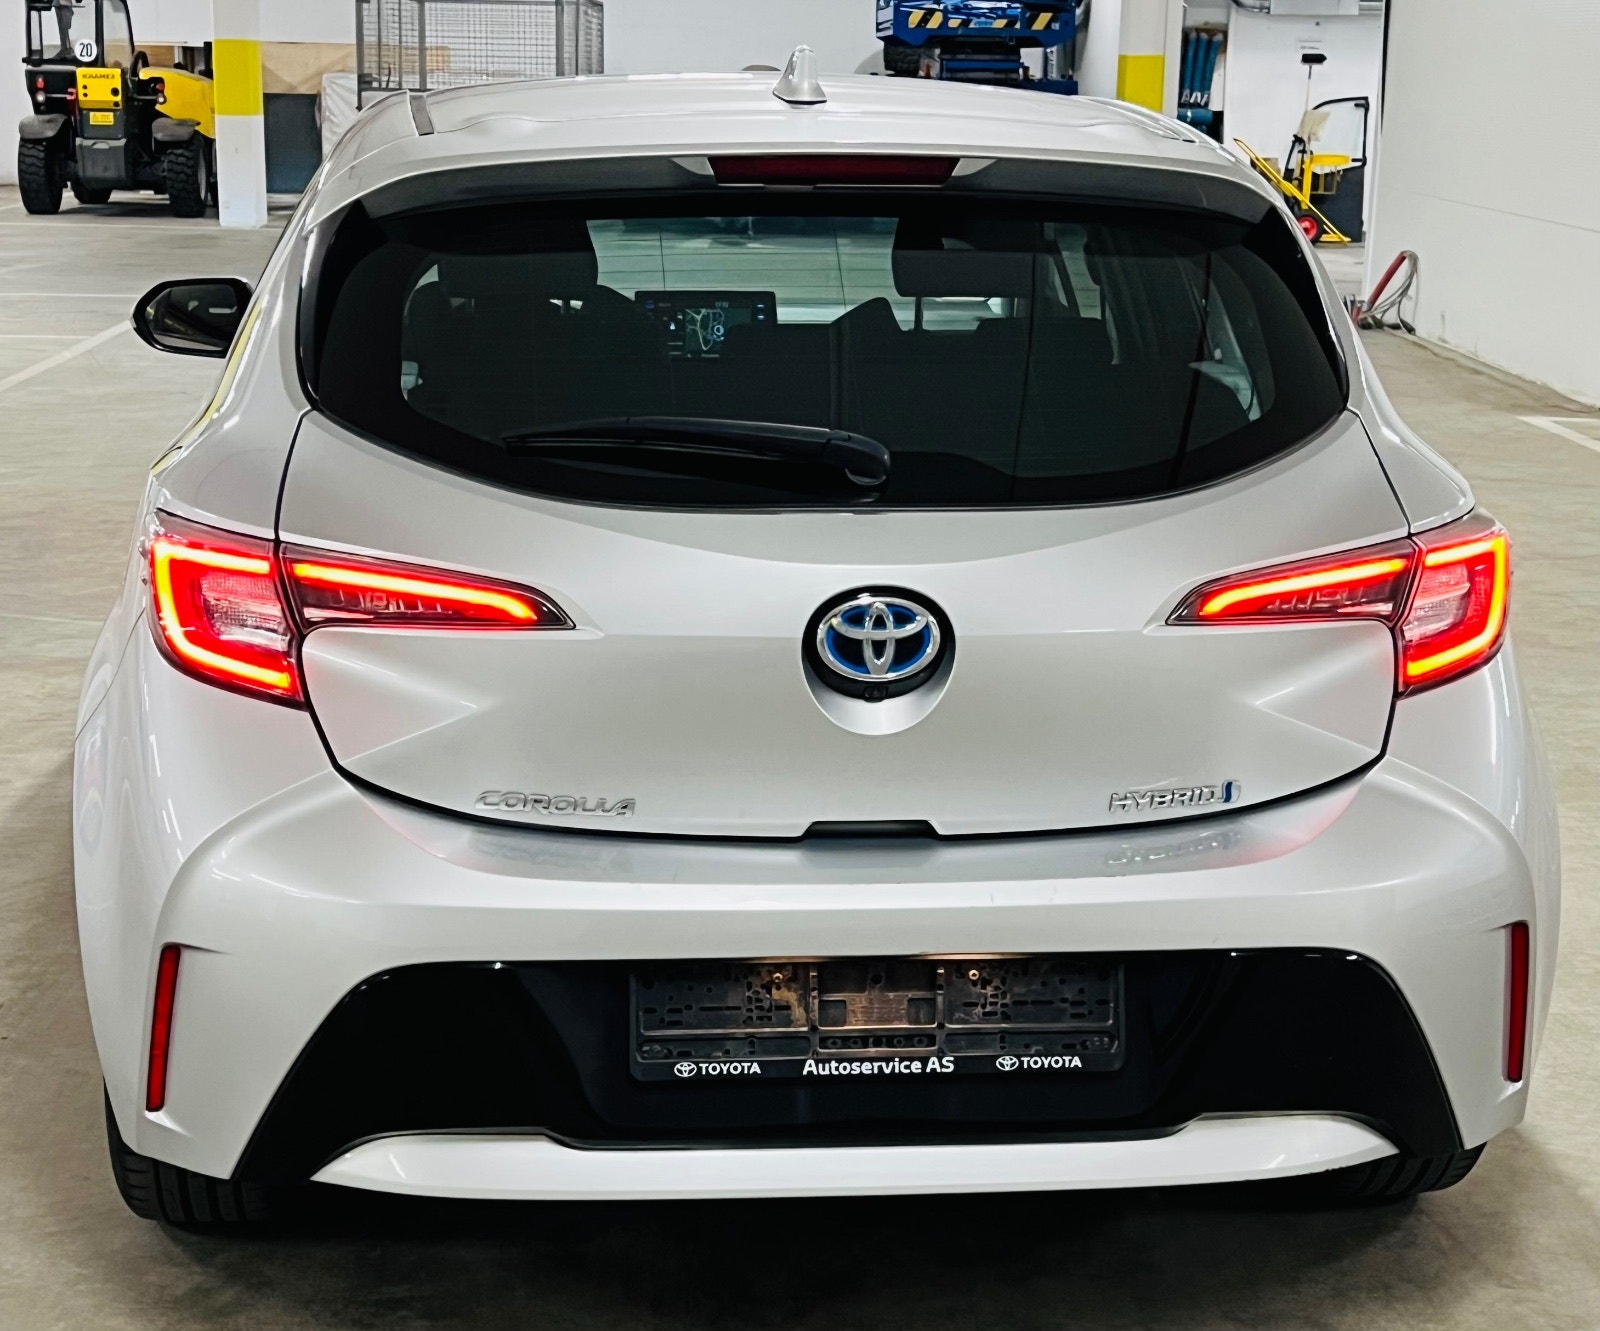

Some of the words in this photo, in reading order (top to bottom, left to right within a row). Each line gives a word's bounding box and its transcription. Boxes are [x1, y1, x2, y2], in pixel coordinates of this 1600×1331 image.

[79, 42, 93, 58] 20
[474, 790, 636, 818] COROLLA
[1108, 785, 1216, 812] HYBRID
[699, 1062, 761, 1075] TOYOTA
[802, 1057, 922, 1076] Autoservice
[926, 1056, 955, 1073] AS
[1021, 1056, 1082, 1069] TOYOTA
